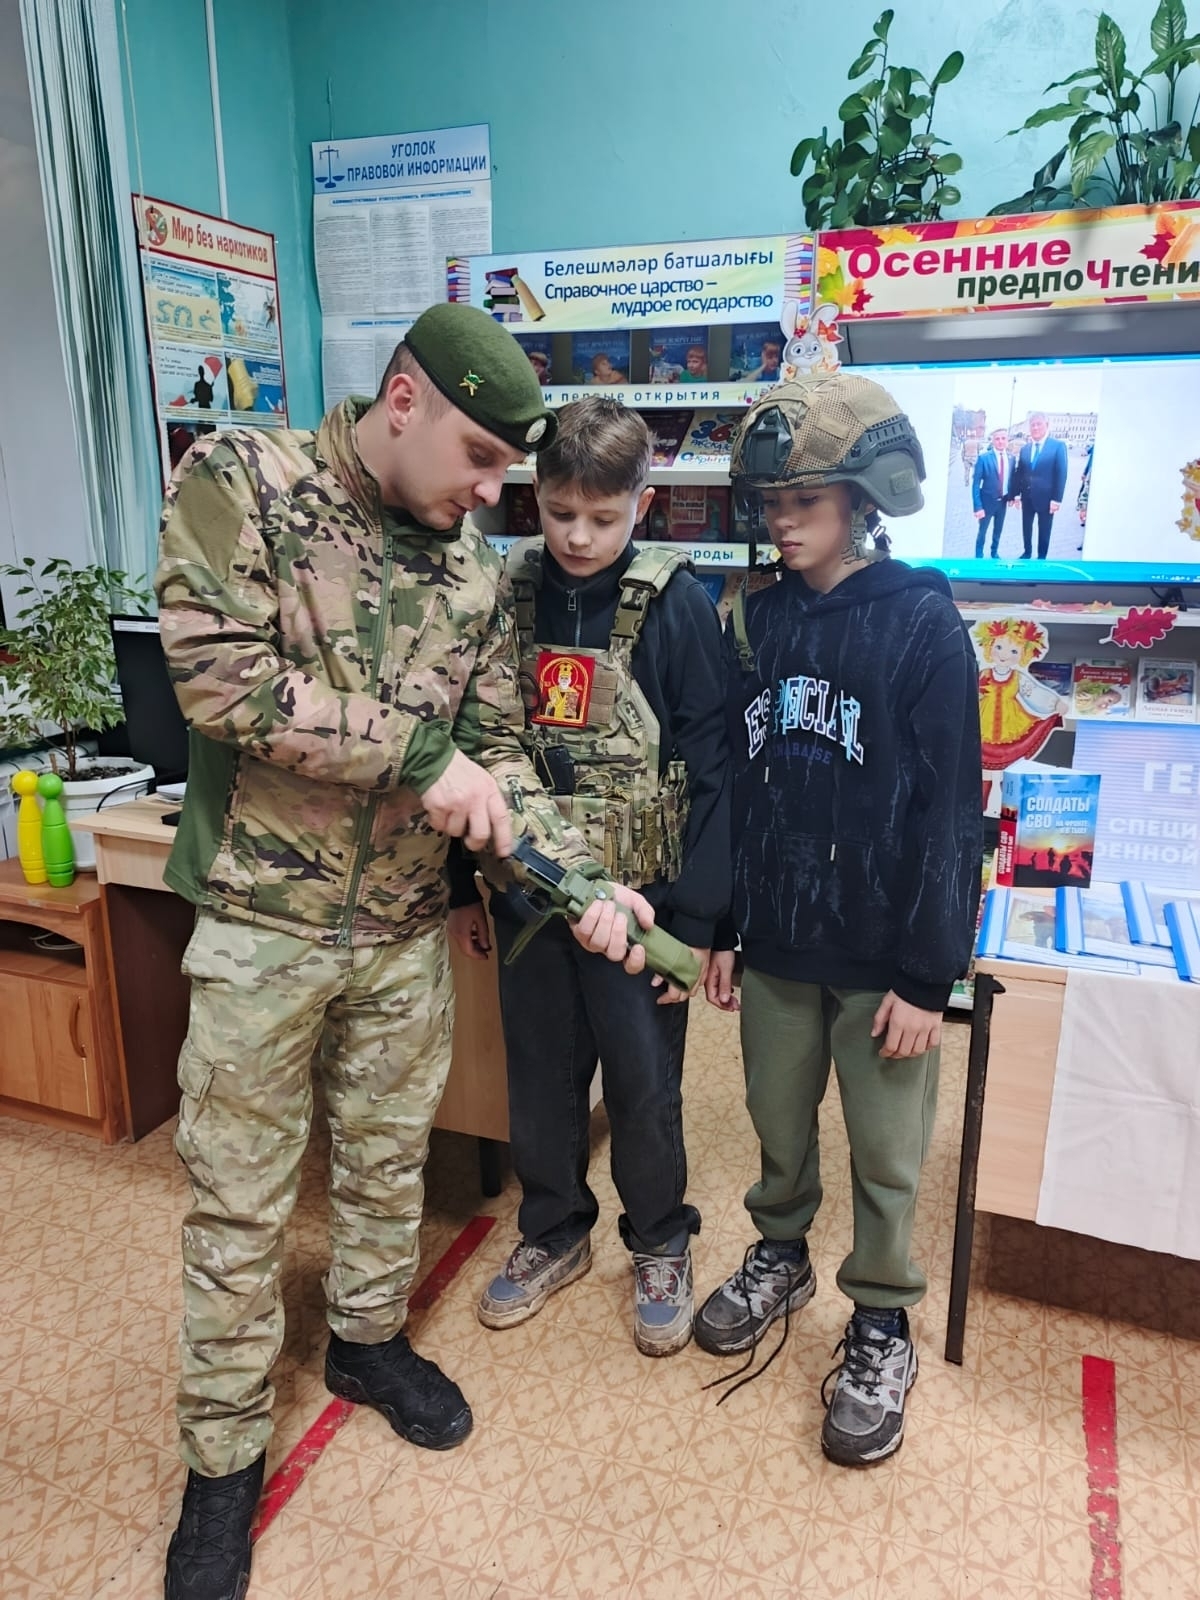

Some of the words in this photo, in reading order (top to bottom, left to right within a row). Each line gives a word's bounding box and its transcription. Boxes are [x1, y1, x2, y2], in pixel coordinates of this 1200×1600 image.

[391, 140, 436, 159] УГОЛОК
[347, 163, 404, 182] ПРАВОВОЙ
[407, 155, 487, 176] ИНФОРМАЦИИ
[171, 216, 194, 248] Мир
[196, 223, 213, 249] без
[216, 235, 268, 263] наркотиков
[544, 259, 658, 277] Белешмәләр
[664, 249, 773, 271] батшалығы
[848, 239, 1071, 279] Осенние
[544, 282, 637, 302] Справочное
[640, 279, 702, 297] царство
[611, 298, 672, 318] мудрое
[675, 293, 774, 314] государство
[545, 392, 552, 402] и
[634, 390, 720, 406] открытия
[691, 420, 738, 444] 36
[689, 550, 733, 561] роды
[1144, 762, 1200, 795] ГЕ
[1027, 796, 1091, 814] СОЛДАТЫ
[1026, 814, 1052, 828] СВО
[1109, 817, 1199, 840] СПЕЦИ
